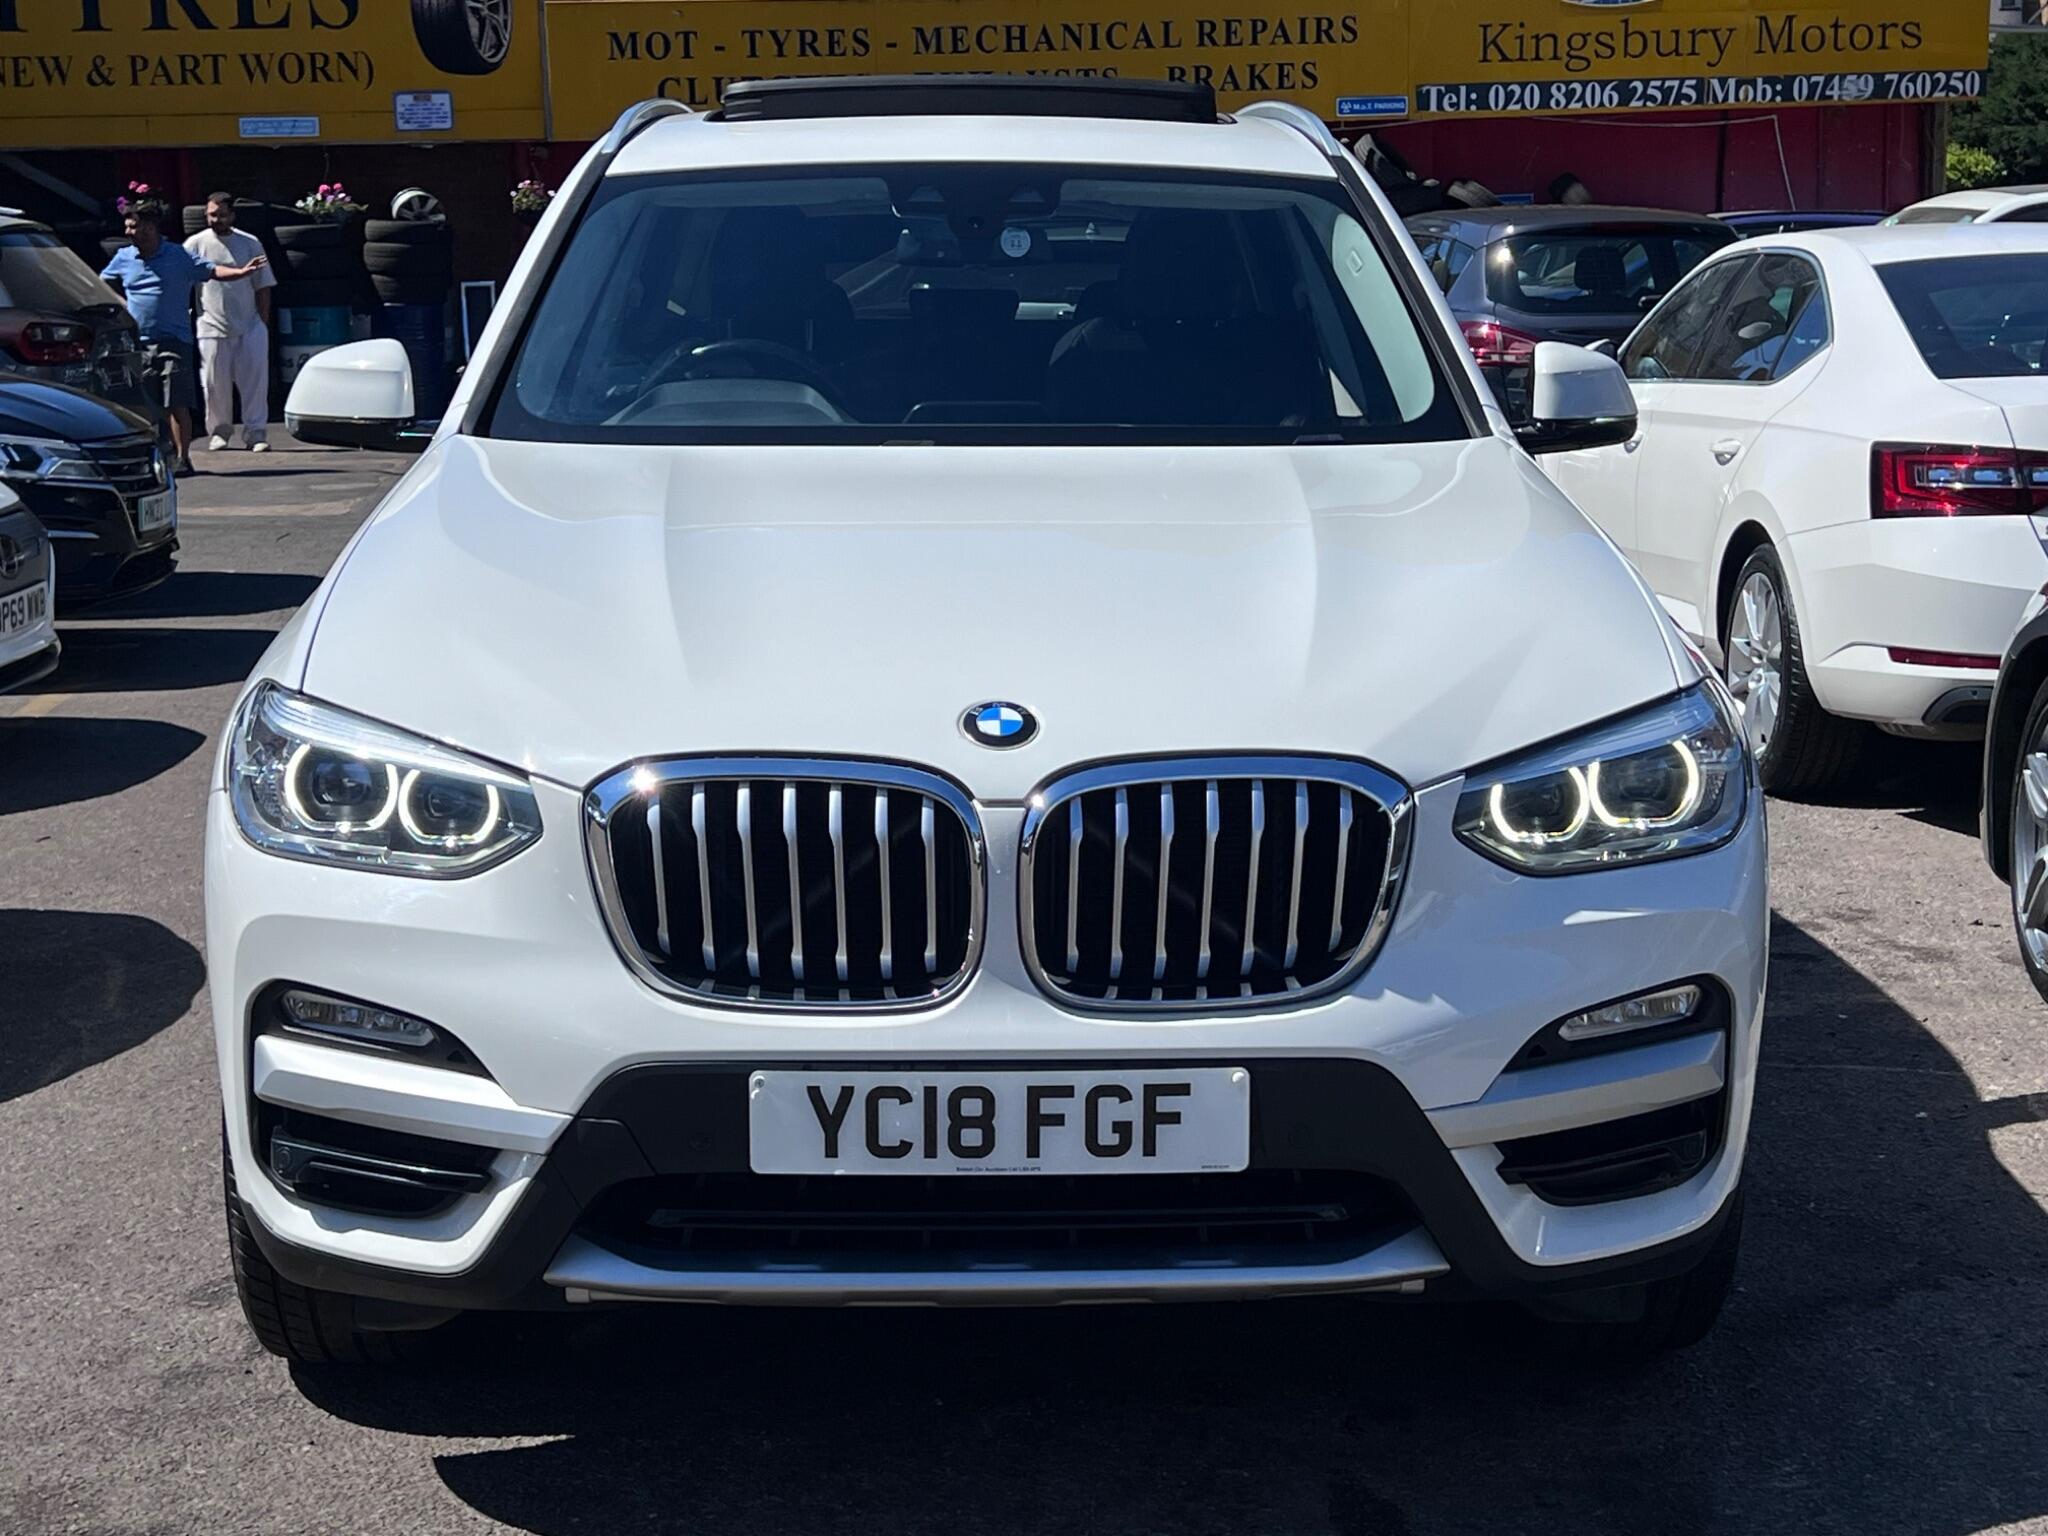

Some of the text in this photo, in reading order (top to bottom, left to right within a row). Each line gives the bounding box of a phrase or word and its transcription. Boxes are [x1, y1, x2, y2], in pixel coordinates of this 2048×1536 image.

[606, 31, 698, 61] MOT
[741, 27, 870, 58] TYRES
[912, 20, 1182, 55] MECHANICAL
[1195, 15, 1358, 48] REPAIRS
[1478, 14, 1922, 71] Kingsbury Motors
[0, 51, 374, 90] EW & PART WORN)
[1423, 86, 1478, 112] Tel:
[1488, 83, 1541, 110] 020
[1549, 81, 1619, 109] 8206
[1628, 79, 1698, 107] 2575
[1708, 77, 1783, 105] Mob:
[1884, 71, 1980, 99] 760250
[0, 595, 25, 633] P69
[806, 1083, 1191, 1159] YC18 FGF
